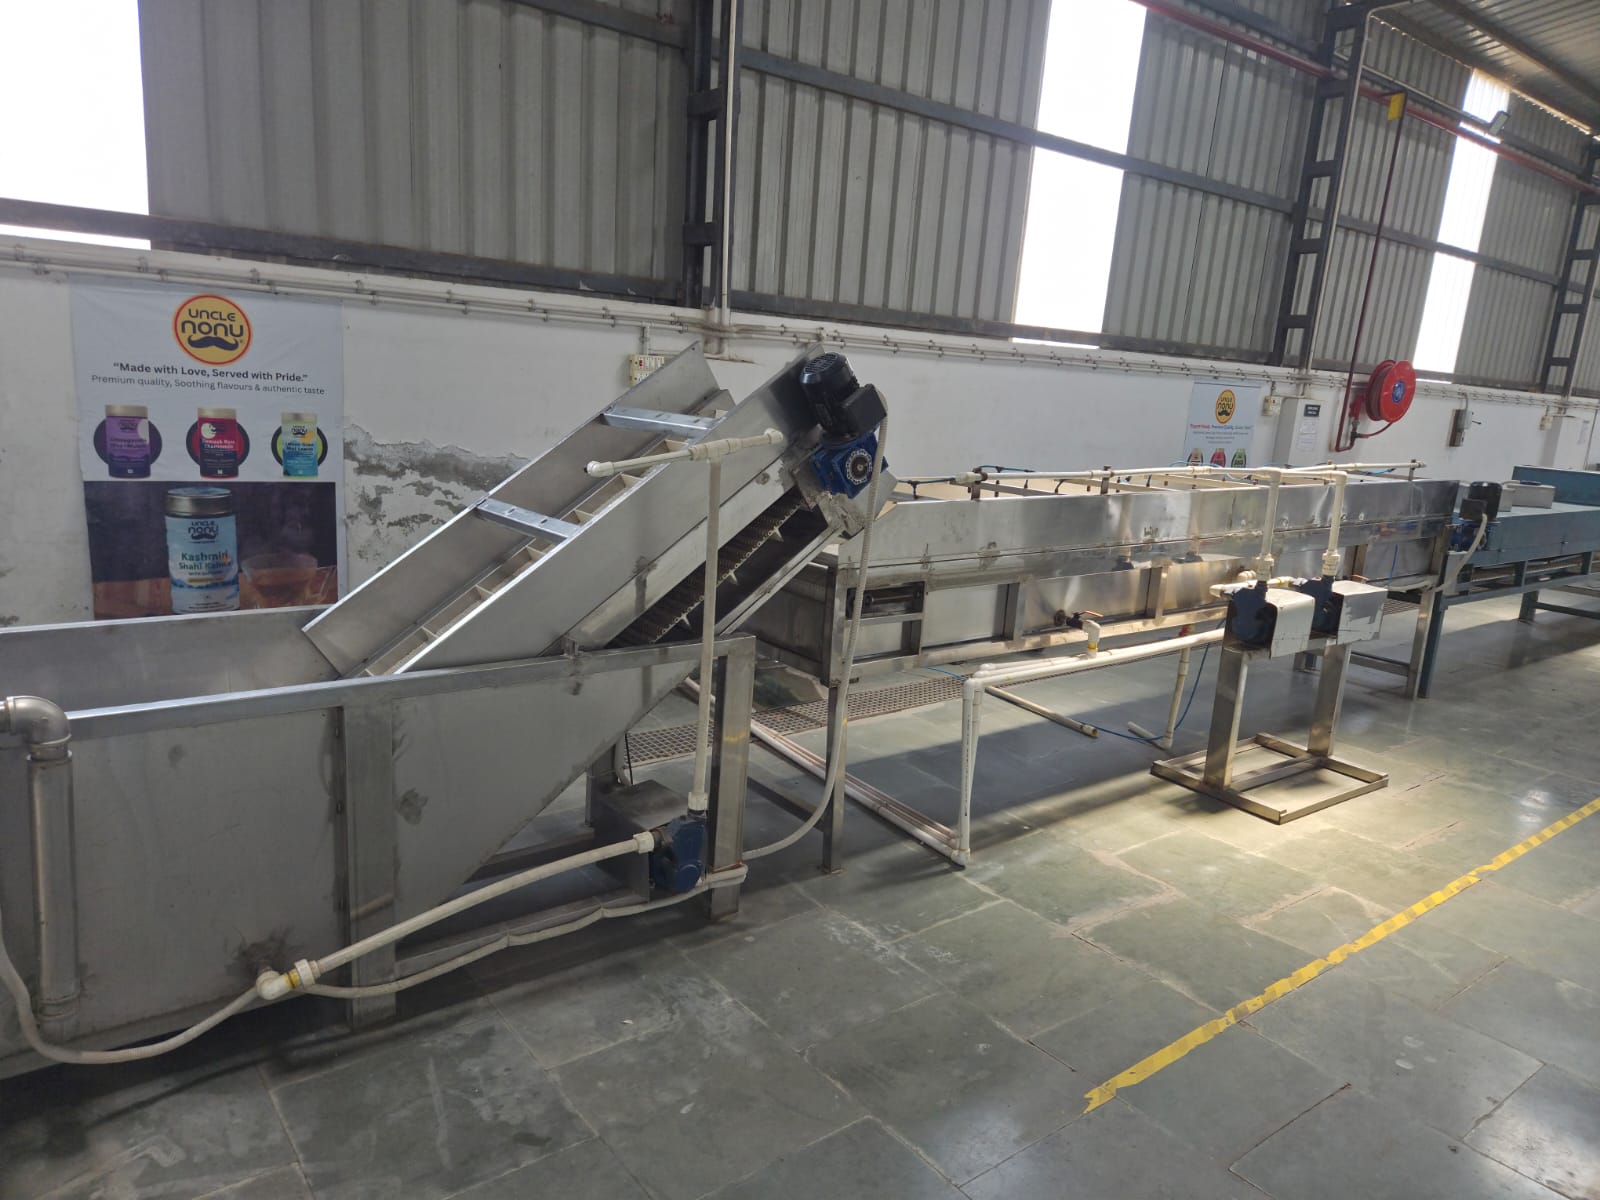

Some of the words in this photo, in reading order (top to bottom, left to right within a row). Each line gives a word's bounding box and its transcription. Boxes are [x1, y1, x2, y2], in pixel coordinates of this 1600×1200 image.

[153, 364, 178, 375] with
[181, 366, 210, 378] Love,
[212, 368, 249, 379] Served
[251, 371, 273, 381] with
[91, 374, 136, 385] Premium
[137, 377, 173, 388] quality,
[174, 379, 216, 390] Soothing
[217, 381, 253, 392] flavours
[254, 384, 261, 392] &
[262, 384, 302, 394] authentic
[304, 386, 325, 395] taste
